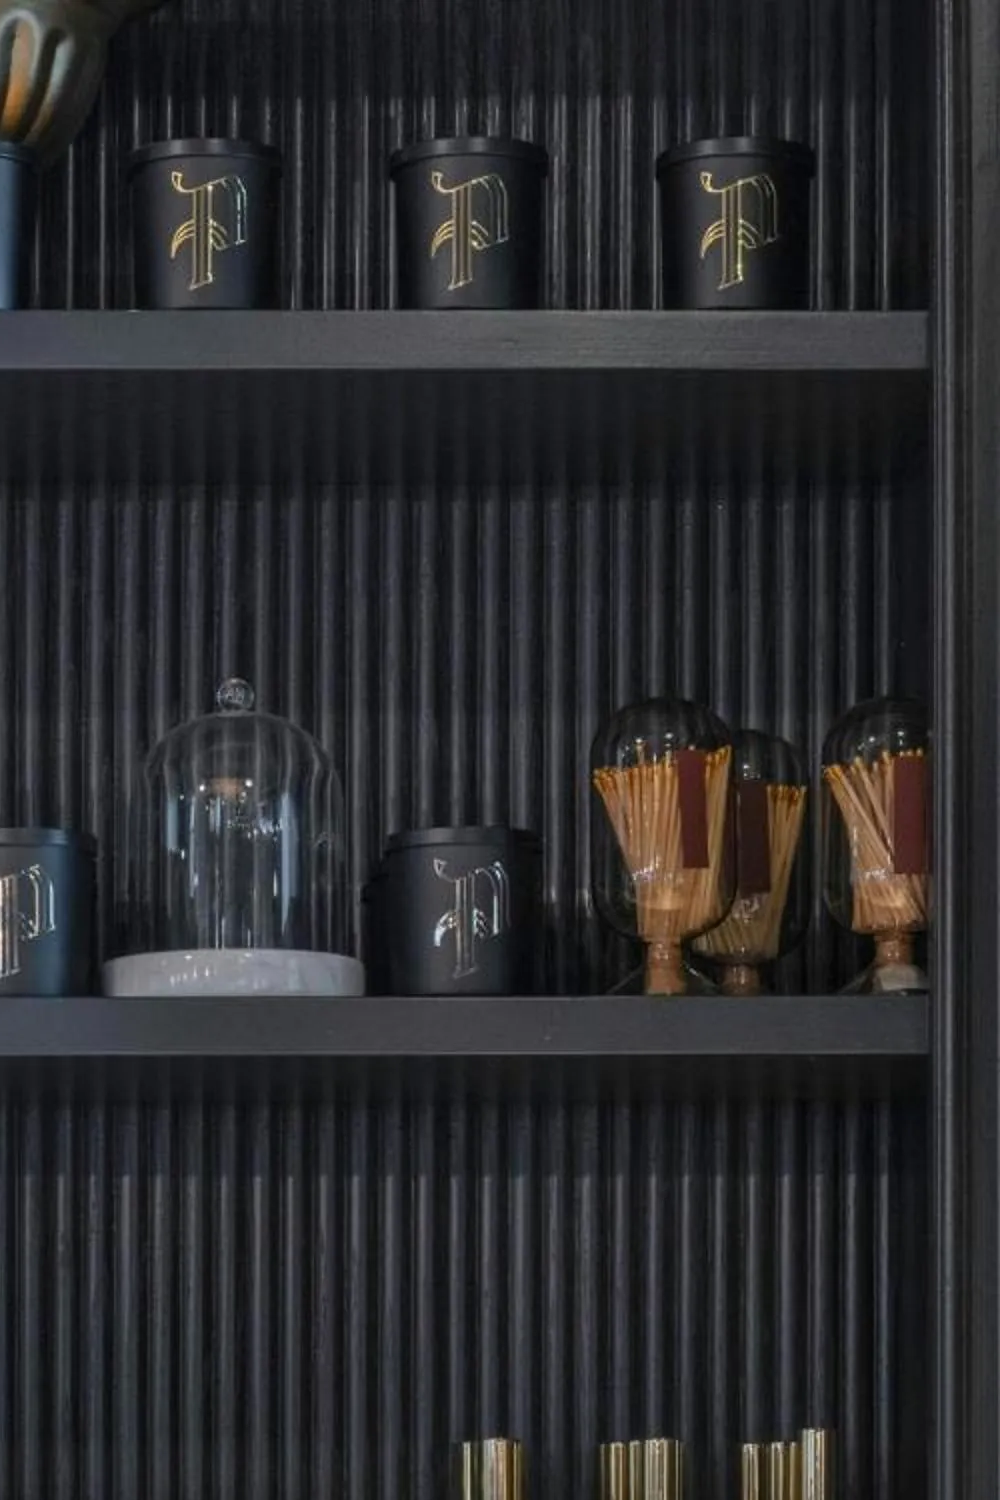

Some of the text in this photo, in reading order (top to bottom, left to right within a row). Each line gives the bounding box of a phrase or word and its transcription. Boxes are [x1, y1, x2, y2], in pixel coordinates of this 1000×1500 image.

[171, 171, 247, 290] P
[431, 171, 509, 291] P
[701, 171, 778, 290] P
